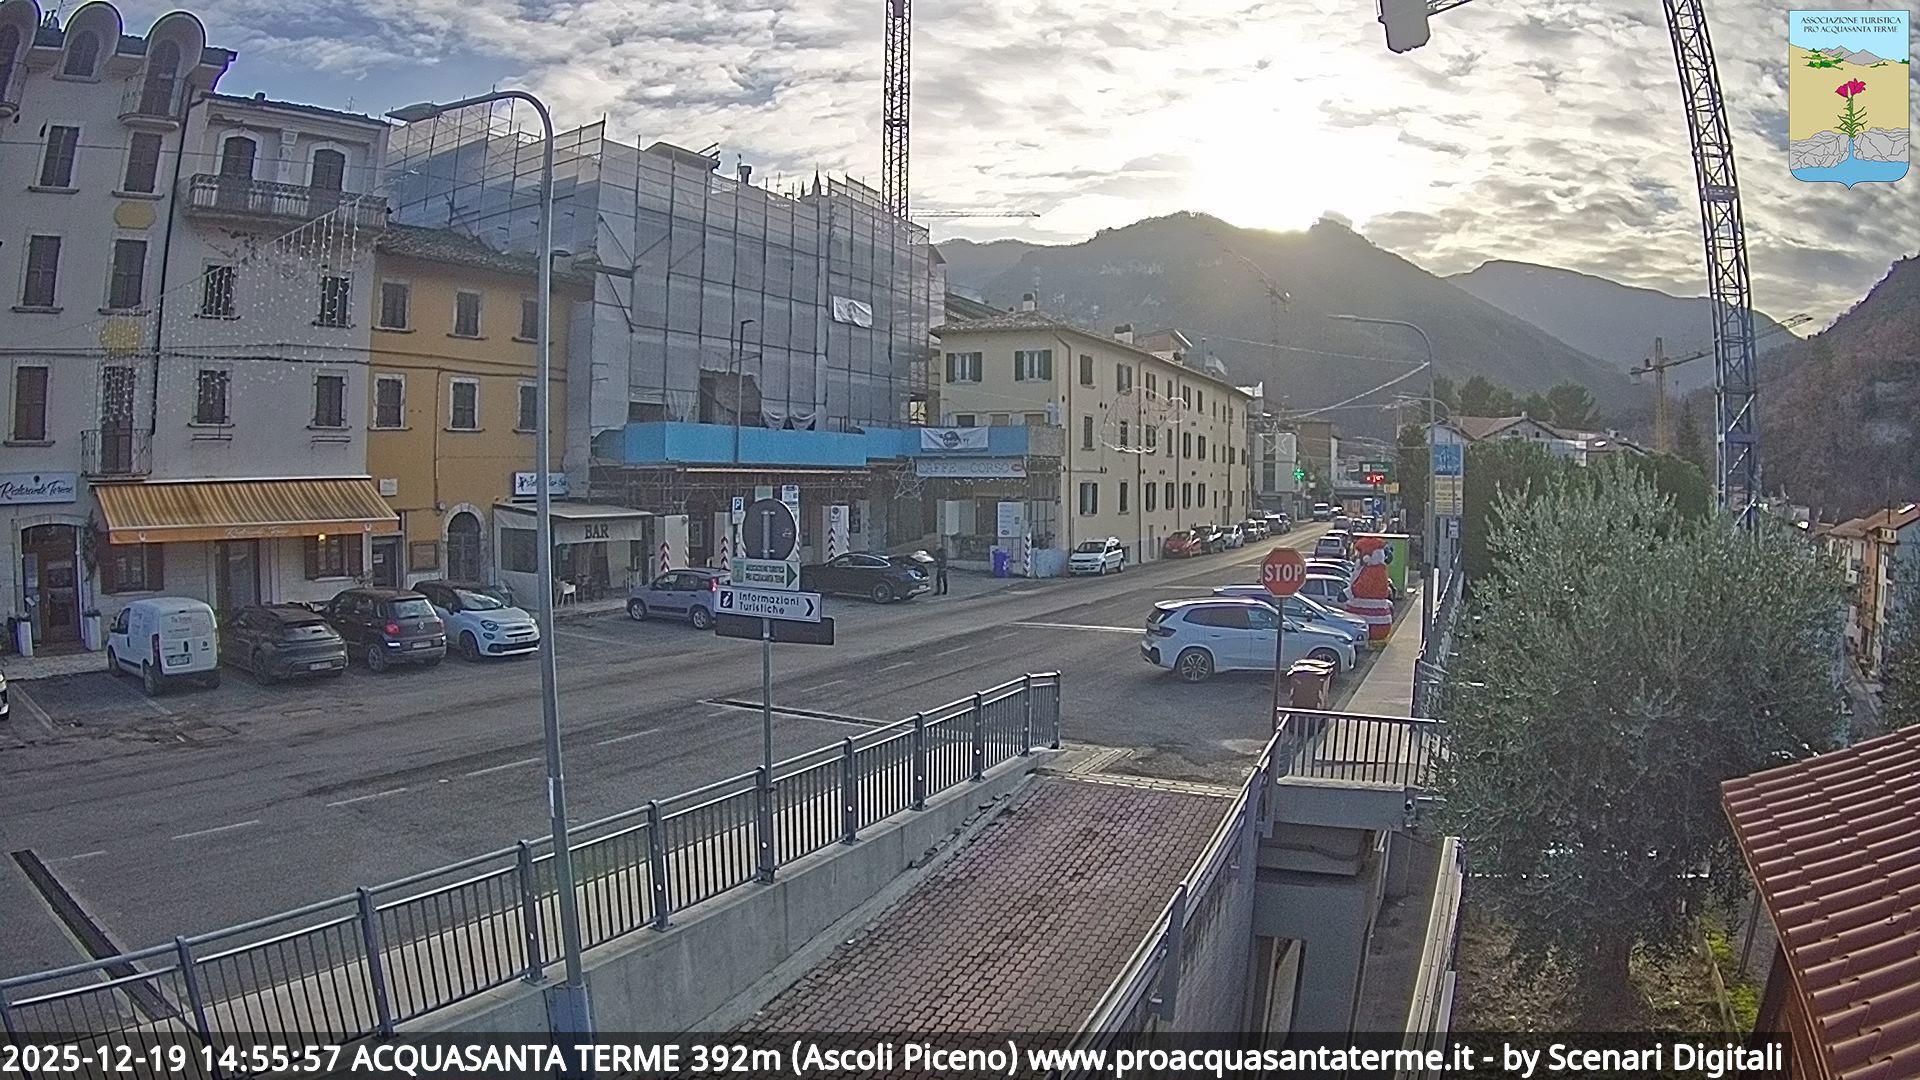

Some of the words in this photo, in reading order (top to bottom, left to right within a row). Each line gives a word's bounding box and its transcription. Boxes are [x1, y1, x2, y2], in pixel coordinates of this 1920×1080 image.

[970, 462, 1010, 473] CORSO
[584, 524, 609, 539] BAR
[1264, 563, 1303, 582] STOP
[739, 592, 800, 606] Informazioni
[739, 601, 785, 615] Turistiche
